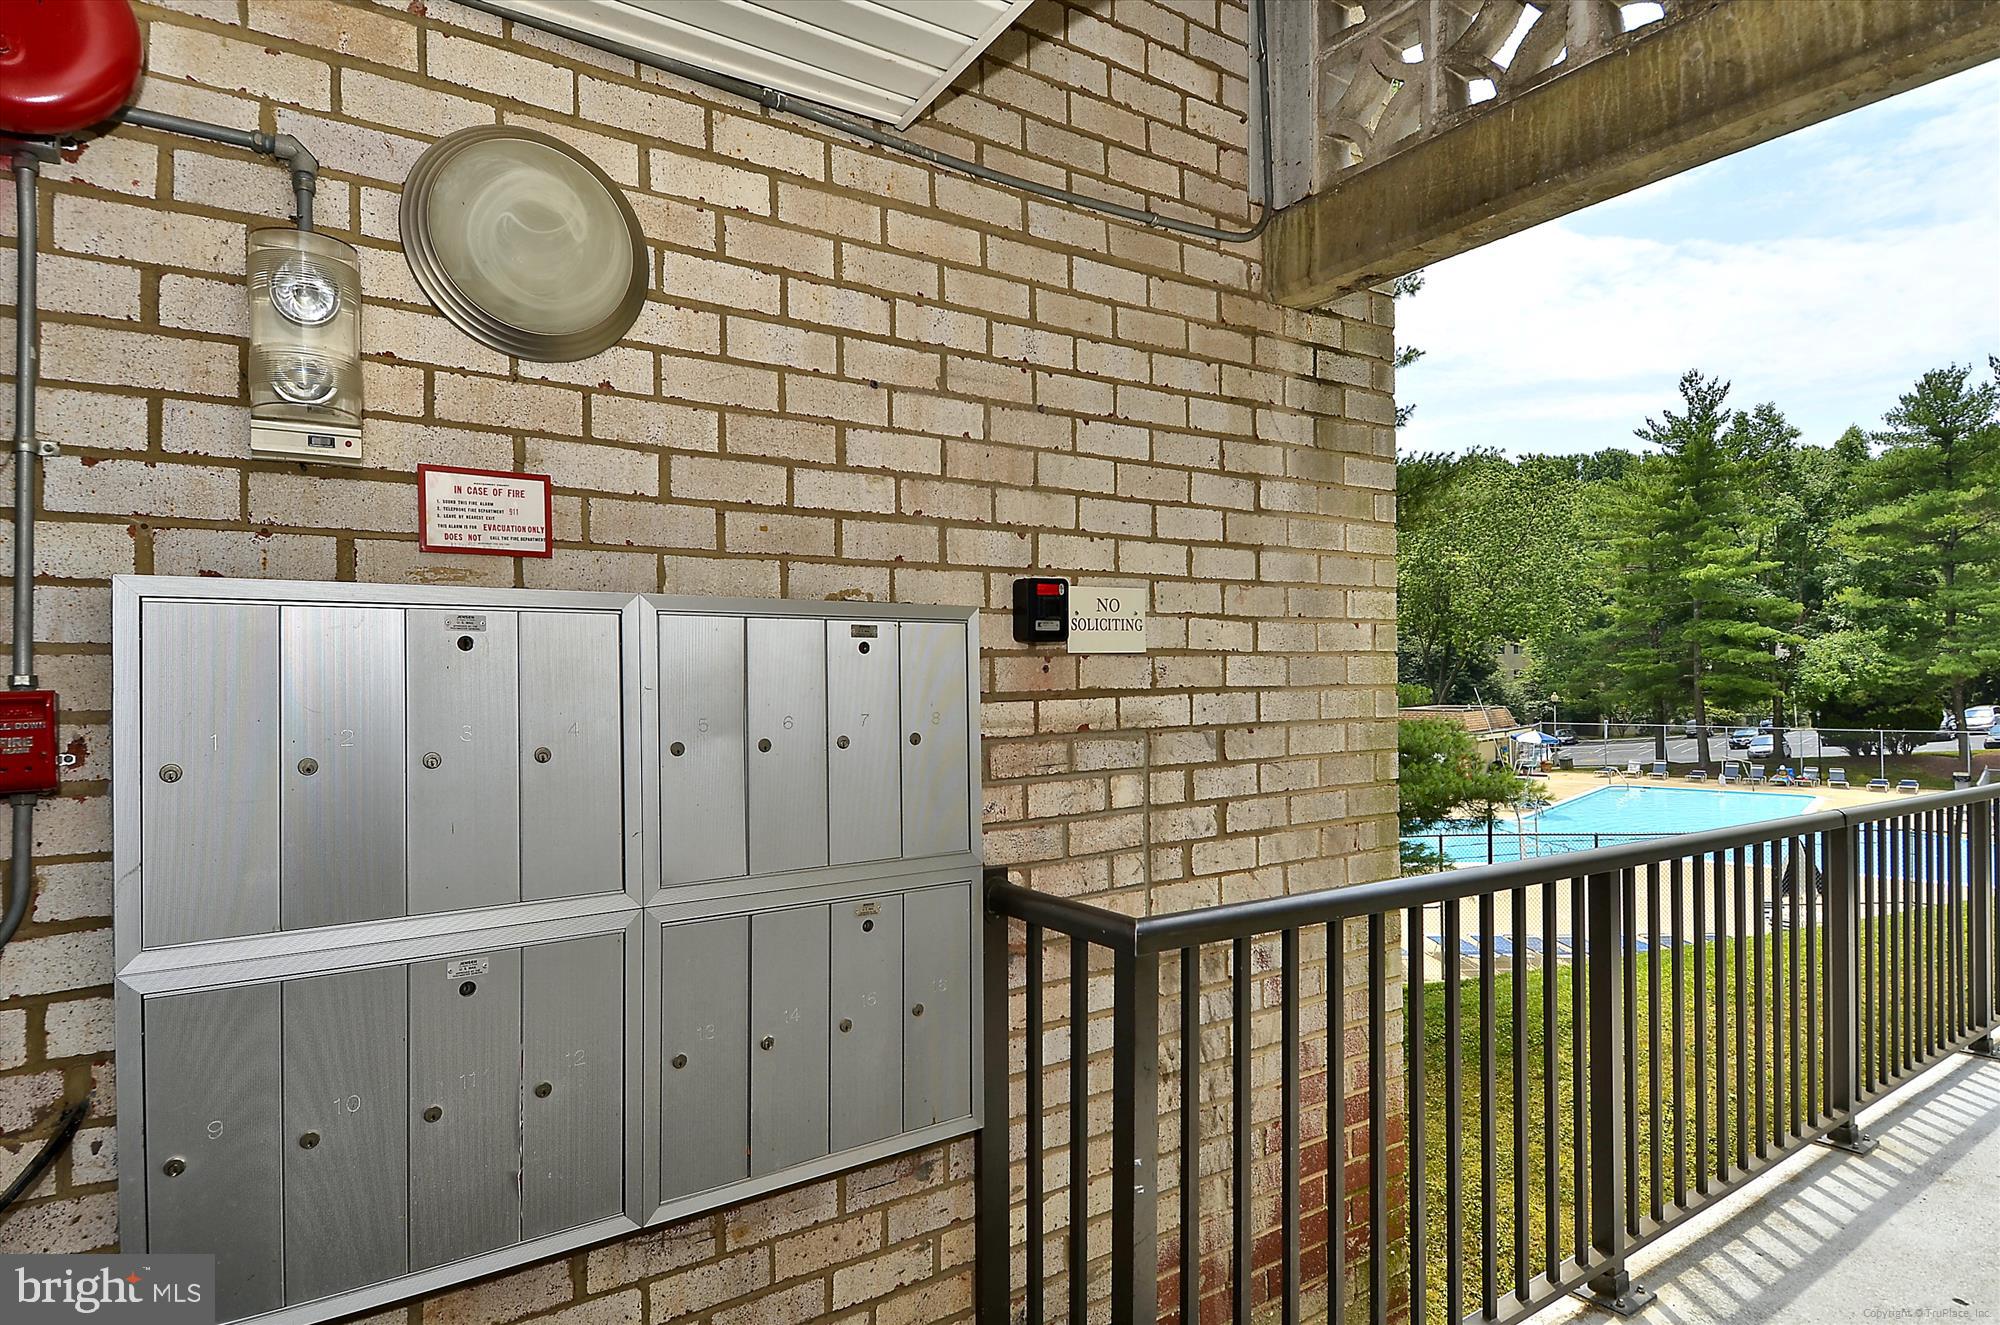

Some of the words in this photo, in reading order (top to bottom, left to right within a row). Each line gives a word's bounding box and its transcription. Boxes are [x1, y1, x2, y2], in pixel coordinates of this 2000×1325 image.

[453, 485, 462, 494] IN
[467, 486, 488, 496] CASE
[492, 488, 503, 497] OF
[507, 489, 525, 498] FIRE
[508, 508, 519, 516] 911
[483, 524, 526, 532] EVACUATION
[527, 526, 545, 534] ONLY
[444, 533, 463, 541] DOES
[467, 534, 482, 542] NOT
[1096, 598, 1120, 613] NO
[1070, 617, 1143, 632] SOLICITING
[698, 718, 709, 733] 5
[783, 715, 794, 729] 6
[861, 713, 869, 727] 7
[931, 711, 941, 725] 8
[460, 725, 472, 742] 3
[568, 722, 579, 736] 4
[209, 733, 217, 751] 1
[340, 729, 354, 747] 2
[784, 1008, 800, 1023] 14
[459, 1072, 476, 1090] 11
[334, 1094, 361, 1115] 10
[207, 1120, 223, 1140] 9
